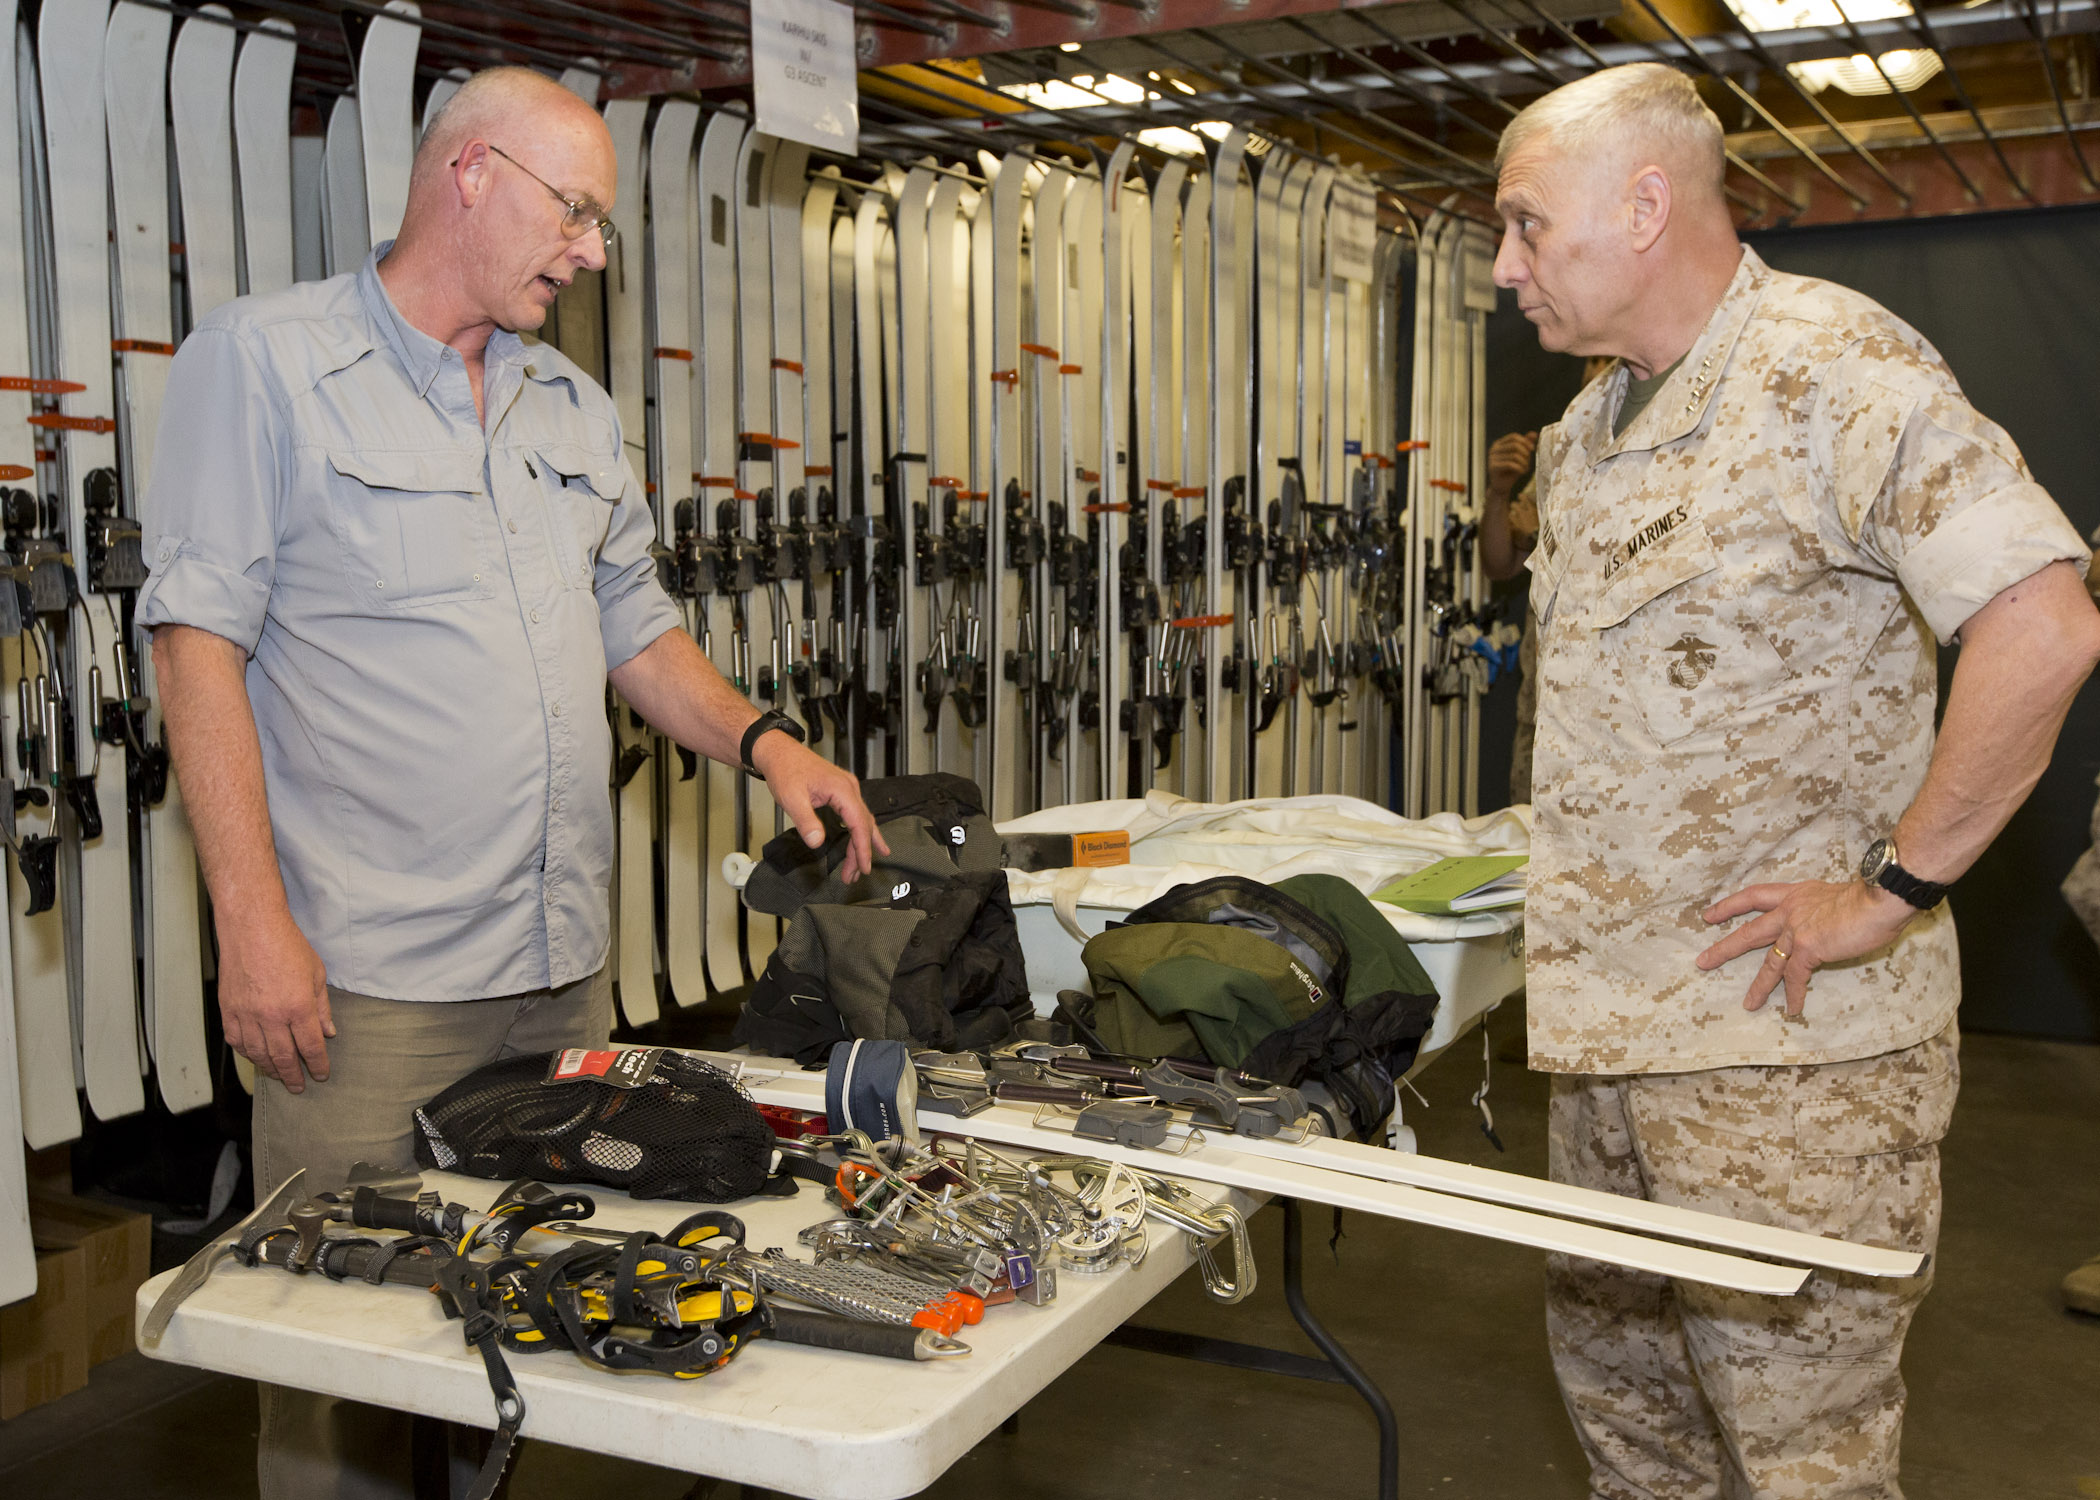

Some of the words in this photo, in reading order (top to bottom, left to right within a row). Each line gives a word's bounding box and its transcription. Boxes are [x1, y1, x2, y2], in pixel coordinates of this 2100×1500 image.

[1604, 553, 1624, 580] U.S.
[1627, 504, 1688, 559] MARINES
[1087, 841, 1103, 852] Black
[1104, 840, 1127, 850] Diamond
[1289, 961, 1315, 992] berghaus
[621, 1051, 644, 1074] Tech
